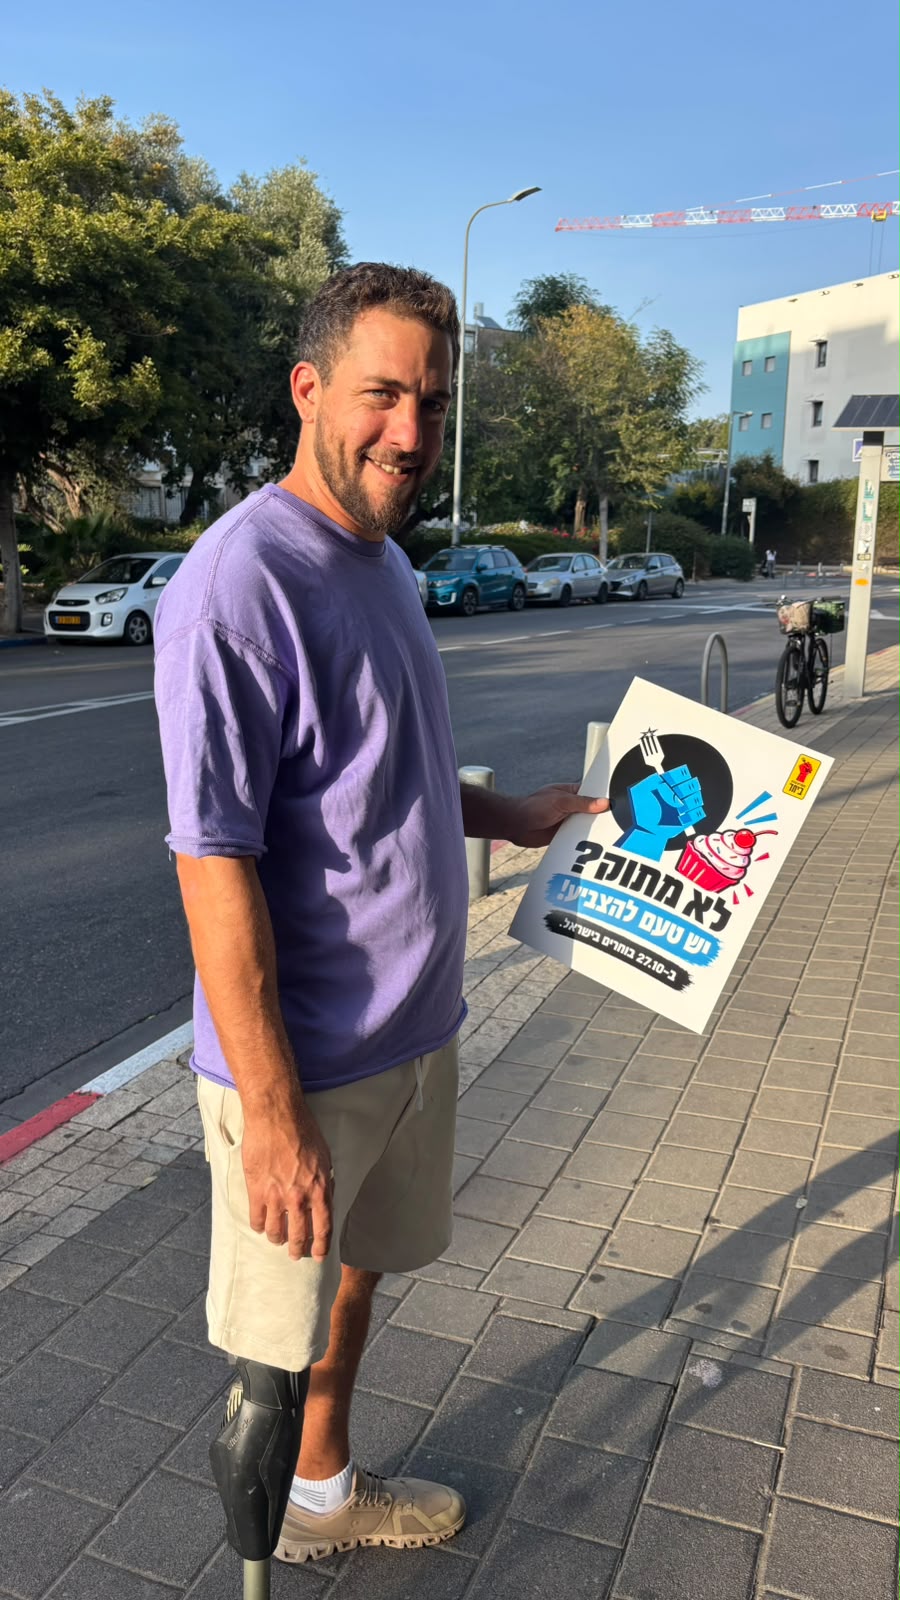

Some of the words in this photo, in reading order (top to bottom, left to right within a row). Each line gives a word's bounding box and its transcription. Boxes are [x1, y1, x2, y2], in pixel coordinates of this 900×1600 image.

[571, 840, 684, 909] מתוק?
[556, 879, 639, 923] להצביע!
[682, 888, 732, 932] לא
[559, 917, 601, 943] בישראל.
[638, 911, 685, 944] טעם
[601, 933, 636, 959] בוחרים
[683, 931, 712, 956] יש
[635, 952, 677, 982] ב-27.10
